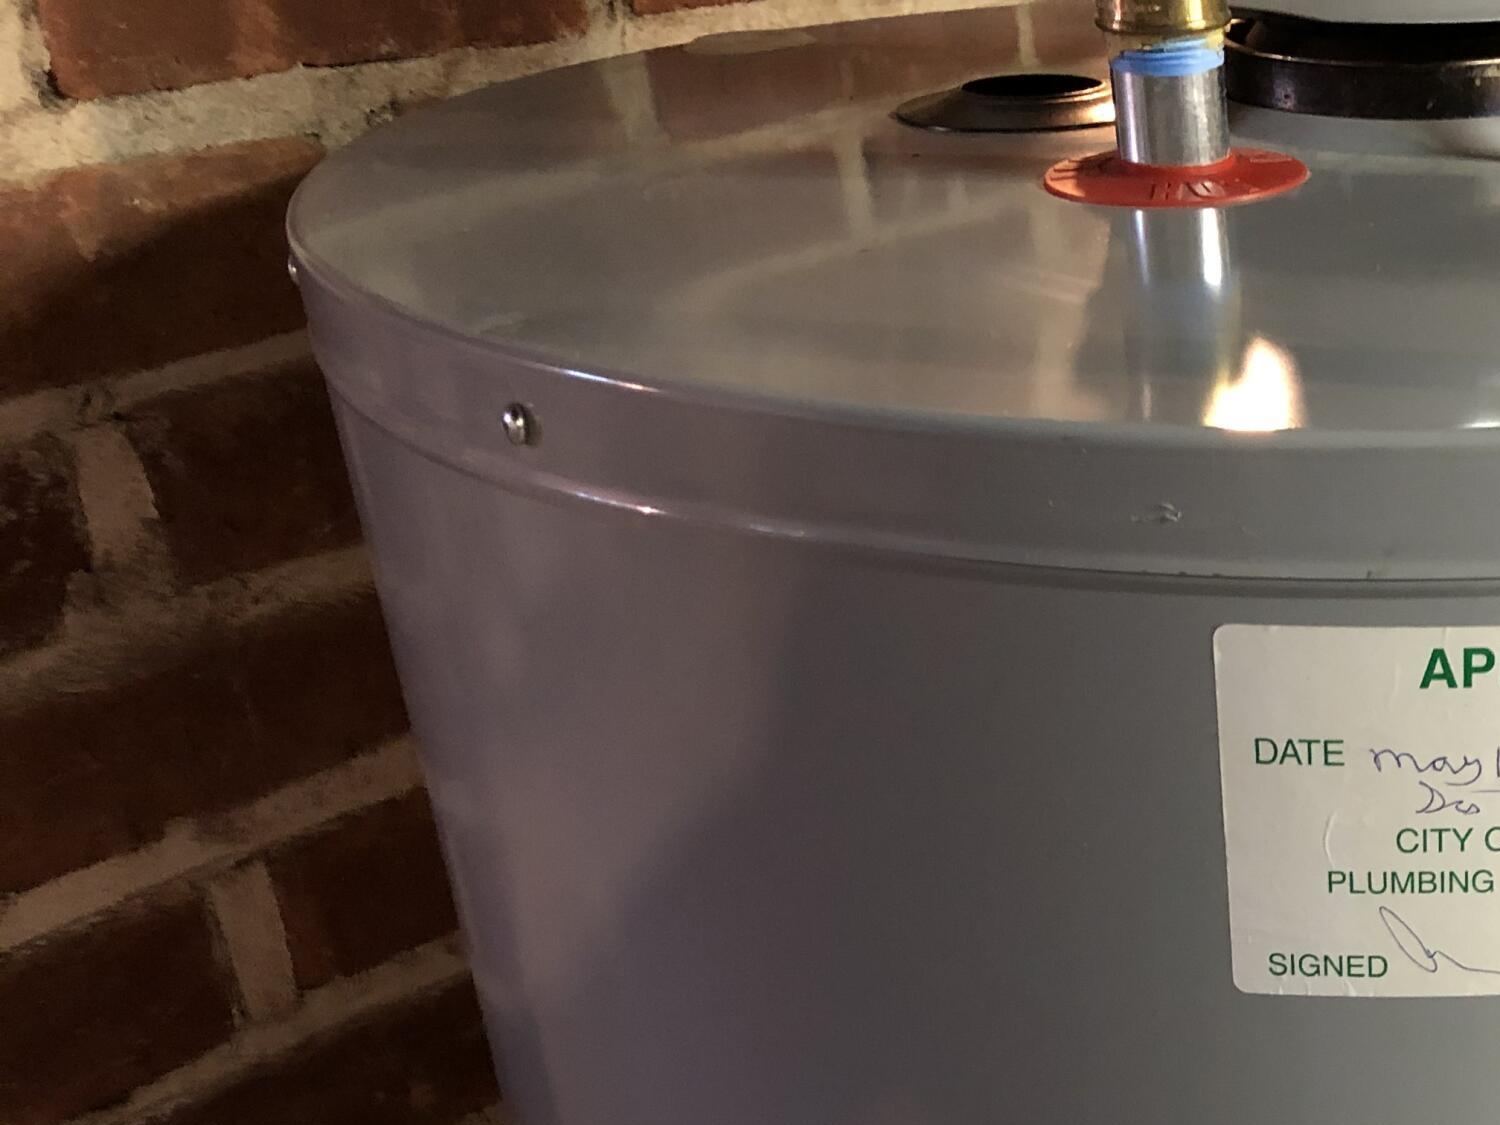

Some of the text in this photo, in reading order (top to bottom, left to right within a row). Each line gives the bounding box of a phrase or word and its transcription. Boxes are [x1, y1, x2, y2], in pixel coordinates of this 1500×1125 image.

[1253, 737, 1345, 767] DATE
[1396, 826, 1474, 854] CITY
[1327, 868, 1496, 895] PLUMBING
[1267, 952, 1389, 980] SIGNED
